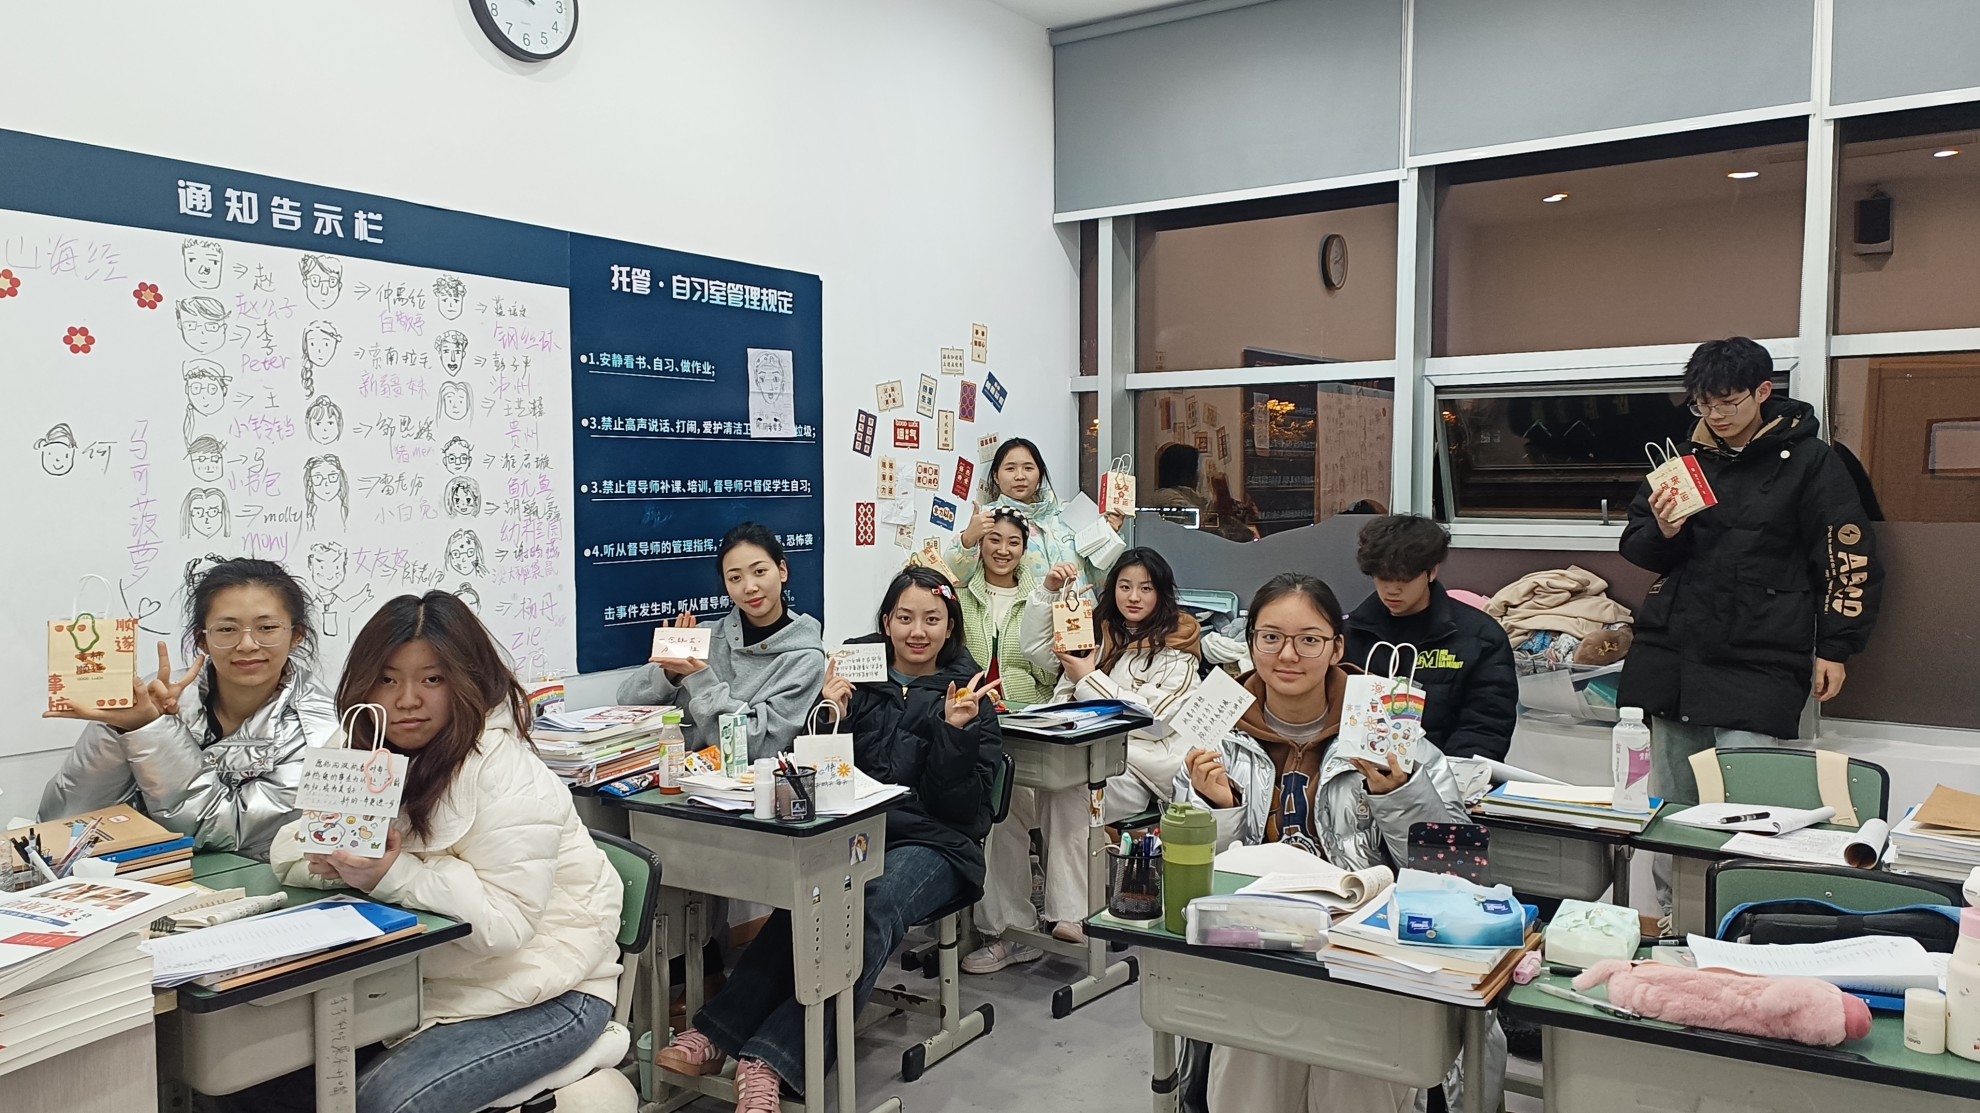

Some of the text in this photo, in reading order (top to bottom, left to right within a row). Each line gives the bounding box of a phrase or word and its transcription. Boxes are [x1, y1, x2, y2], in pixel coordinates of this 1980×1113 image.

[490, 3, 498, 17] 8
[505, 22, 513, 35] 7
[522, 33, 531, 46] 6
[540, 31, 548, 45] 5
[551, 21, 559, 33] 4
[177, 178, 385, 245] 通知告示栏
[5, 234, 128, 282] 山海经
[253, 263, 276, 292] 赵
[610, 264, 794, 314] 托管·自习室管理规定
[235, 293, 297, 320] 赵公子
[256, 319, 277, 355] 李
[241, 354, 291, 373] Peter
[263, 385, 280, 408] 王
[228, 415, 294, 441] 小铃铛
[82, 441, 118, 475] 何
[228, 468, 281, 497] 小书包
